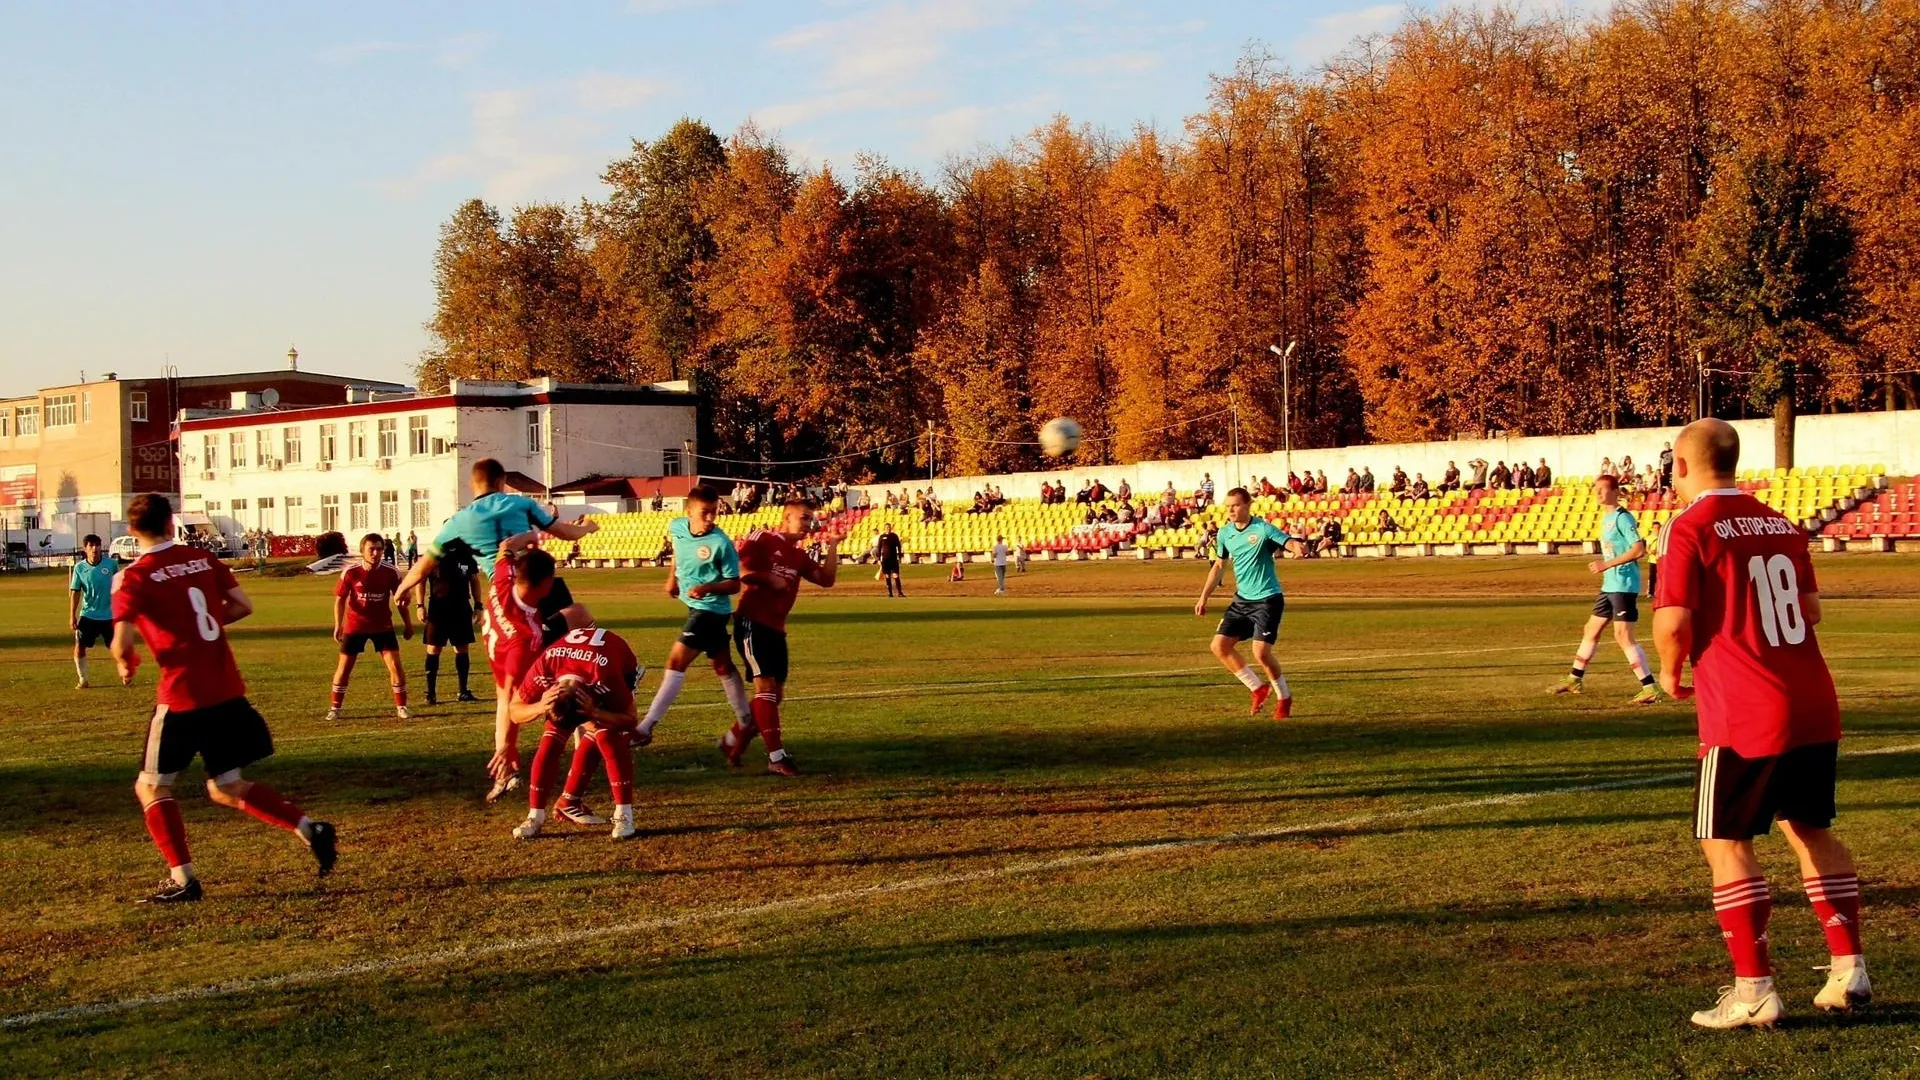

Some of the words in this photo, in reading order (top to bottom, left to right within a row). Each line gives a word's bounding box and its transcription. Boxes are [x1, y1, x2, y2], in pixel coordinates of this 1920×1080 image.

[1713, 519, 1740, 539] ФК
[1735, 516, 1799, 536] ЕГОРЬЕВСК
[1748, 553, 1806, 647] 18
[187, 586, 220, 642] 8
[564, 627, 610, 647] 13
[545, 646, 593, 662] ЕГОРЬЕВСК
[592, 654, 609, 667] ФК
